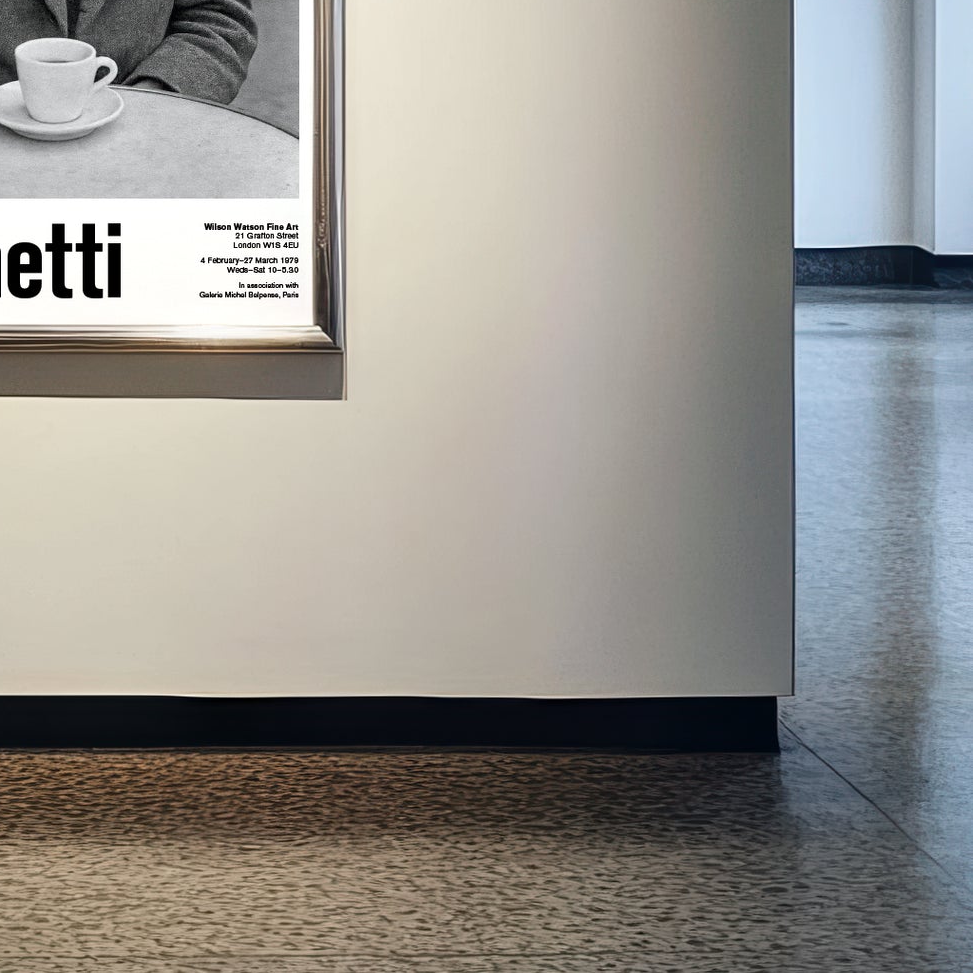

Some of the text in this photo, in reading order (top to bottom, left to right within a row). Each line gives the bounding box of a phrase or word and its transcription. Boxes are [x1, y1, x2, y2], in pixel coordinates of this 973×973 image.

[199, 291, 223, 299] Galerie
[225, 291, 246, 299] Michel
[283, 291, 299, 299] Paris
